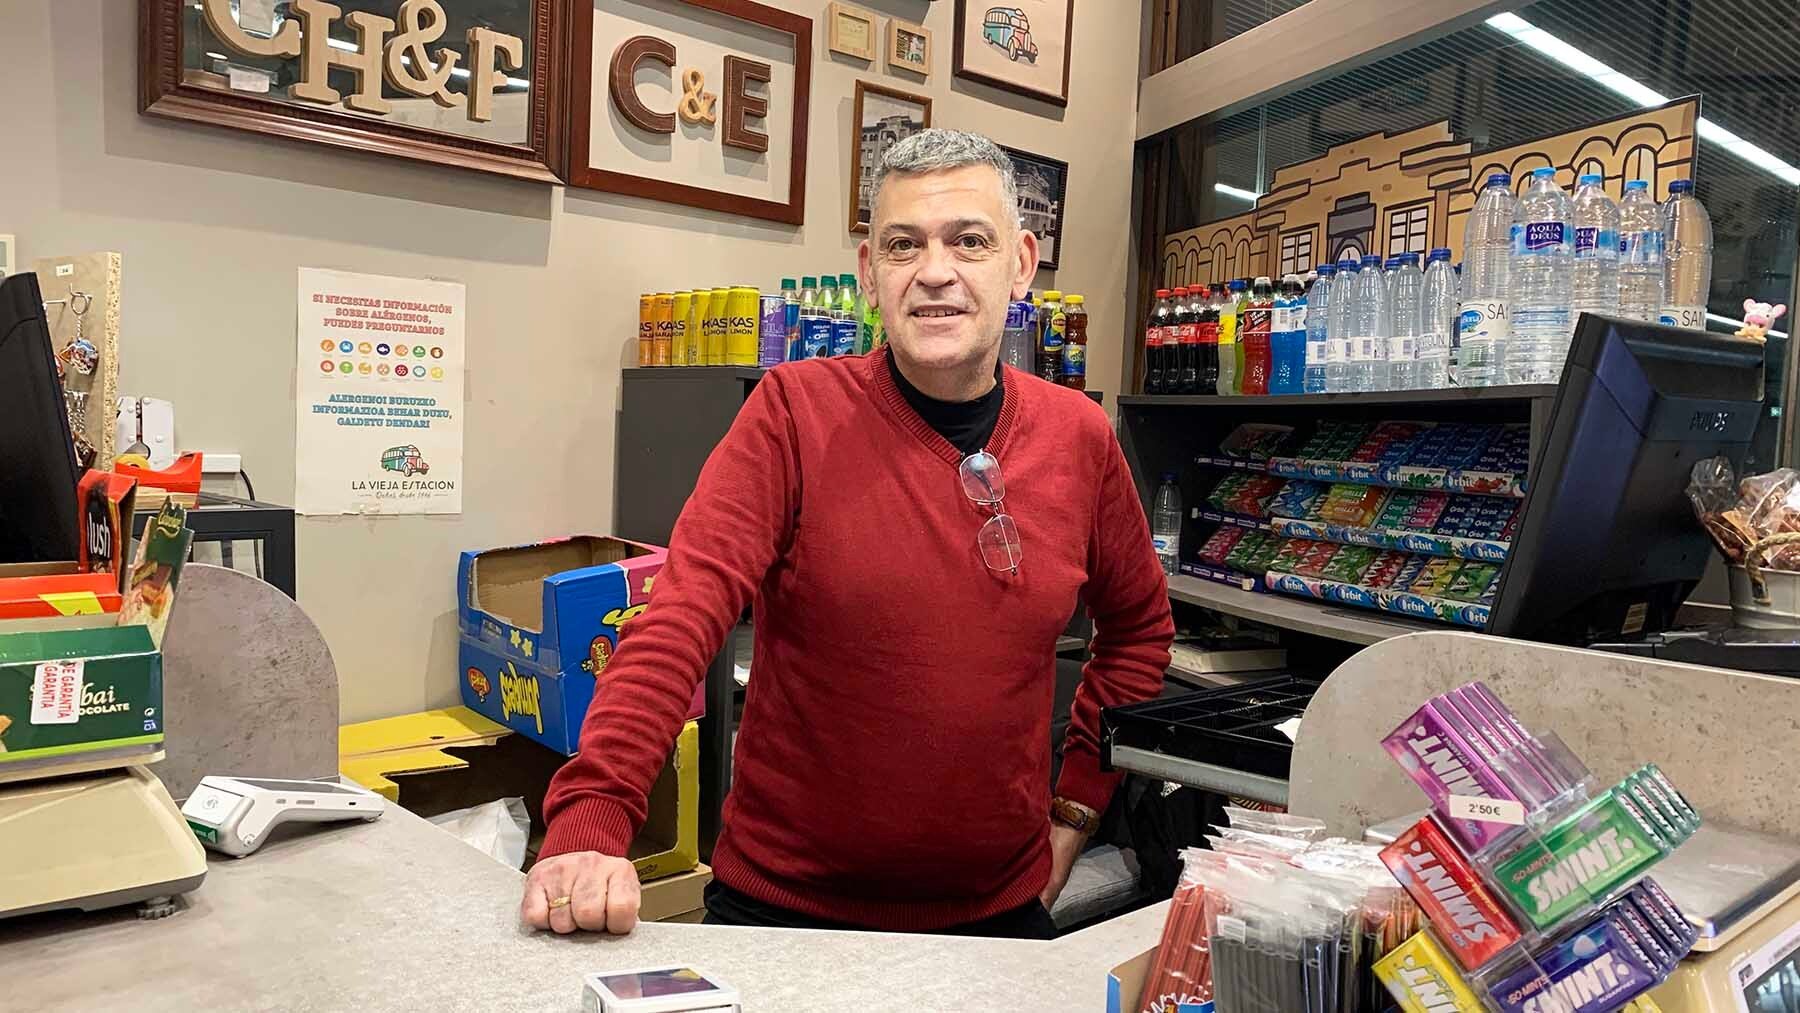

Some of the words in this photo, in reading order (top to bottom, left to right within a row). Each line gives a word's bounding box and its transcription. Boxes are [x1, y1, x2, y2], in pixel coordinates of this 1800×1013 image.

[609, 36, 772, 153] C&E
[1529, 223, 1561, 233] AQUA
[1531, 232, 1560, 241] DEUS
[313, 294, 323, 303] SI
[325, 295, 381, 308] NECESITAS
[383, 299, 452, 314] INFORMACIÓN
[336, 308, 369, 318] SOBRE
[371, 310, 432, 324] ALÉRGENOS,
[729, 317, 754, 328] KAS
[324, 318, 364, 329] PUEDES
[366, 320, 445, 335] PREGUNTARNOS
[328, 394, 387, 405] ALERGENOI
[389, 395, 436, 407] BURUZKO
[312, 405, 386, 416] INFORMAZIOA
[388, 407, 421, 417] BEHAR
[337, 417, 384, 427] GALDETU
[386, 418, 430, 429] DENDARI
[352, 481, 366, 490] LA
[368, 480, 399, 490] VIEJA
[80, 703, 130, 715] OCOLATE
[1408, 735, 1492, 799] MINT
[1528, 827, 1623, 913] SMINT
[1402, 851, 1498, 943] SMINT
